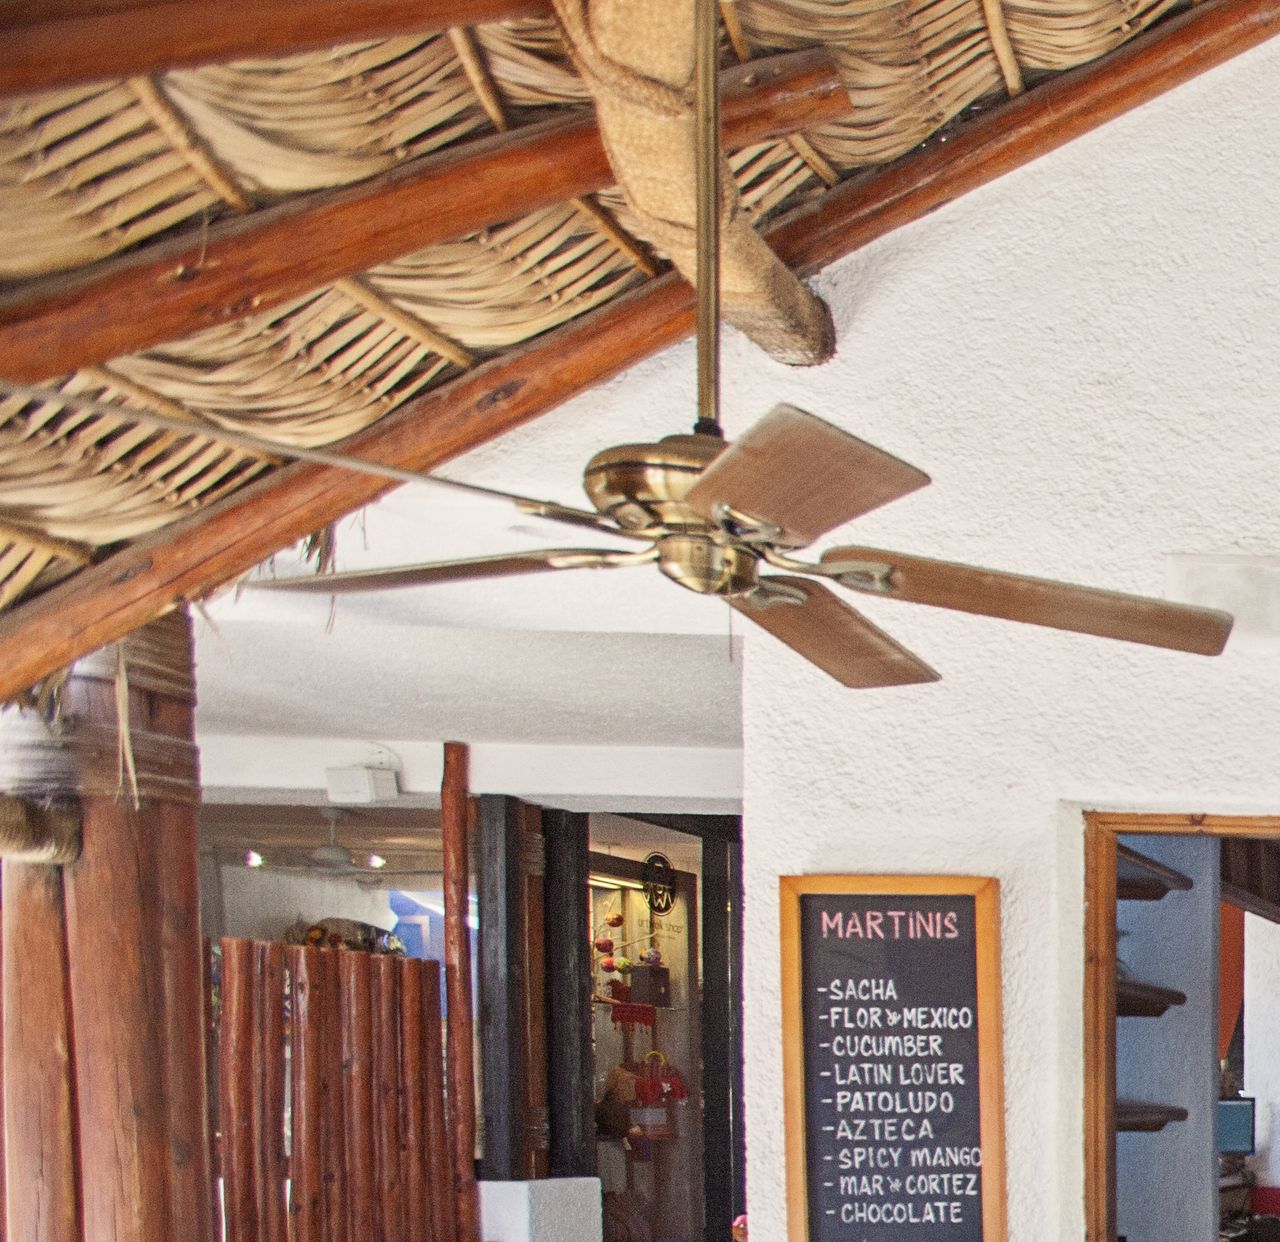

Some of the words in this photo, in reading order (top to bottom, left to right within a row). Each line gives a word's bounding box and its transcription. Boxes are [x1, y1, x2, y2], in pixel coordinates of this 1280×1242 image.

[820, 910, 960, 940] MARTINIS
[902, 1006, 974, 1030] MEXICO
[899, 1062, 966, 1086] LOVER
[910, 1146, 983, 1168] MANGO
[904, 1173, 979, 1197] CORTEZ
